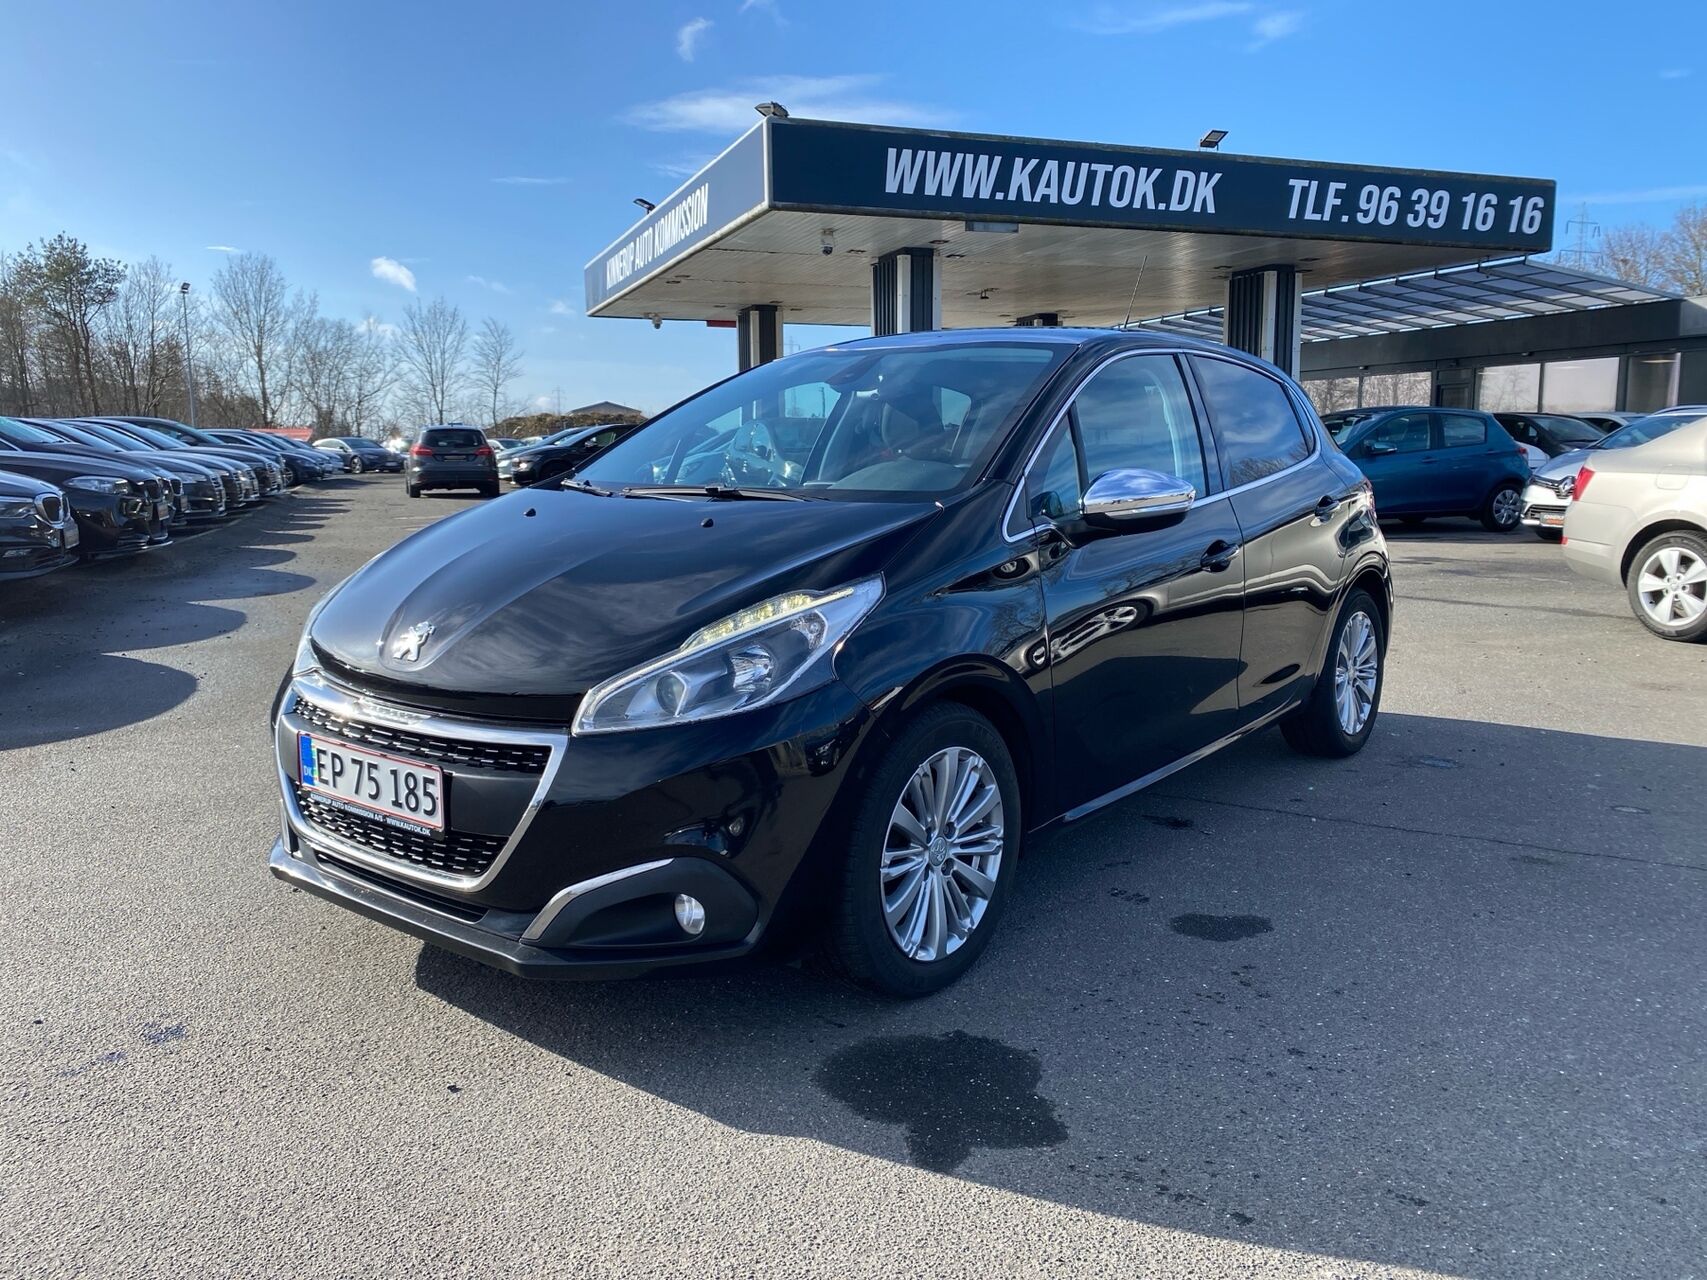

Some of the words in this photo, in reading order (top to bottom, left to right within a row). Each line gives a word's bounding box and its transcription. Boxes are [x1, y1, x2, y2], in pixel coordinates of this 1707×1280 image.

[885, 147, 1223, 213] WWW.KAUTOK.DK
[1288, 178, 1349, 223] TLF.
[1356, 184, 1401, 226] 96
[1406, 188, 1450, 229] 39
[1461, 192, 1498, 232] 16
[1508, 196, 1545, 235] 16
[635, 226, 653, 271] AUTO
[654, 182, 709, 259] KOMMISSION
[316, 748, 344, 788] EP
[350, 757, 380, 801] 75
[390, 768, 437, 817] 185
